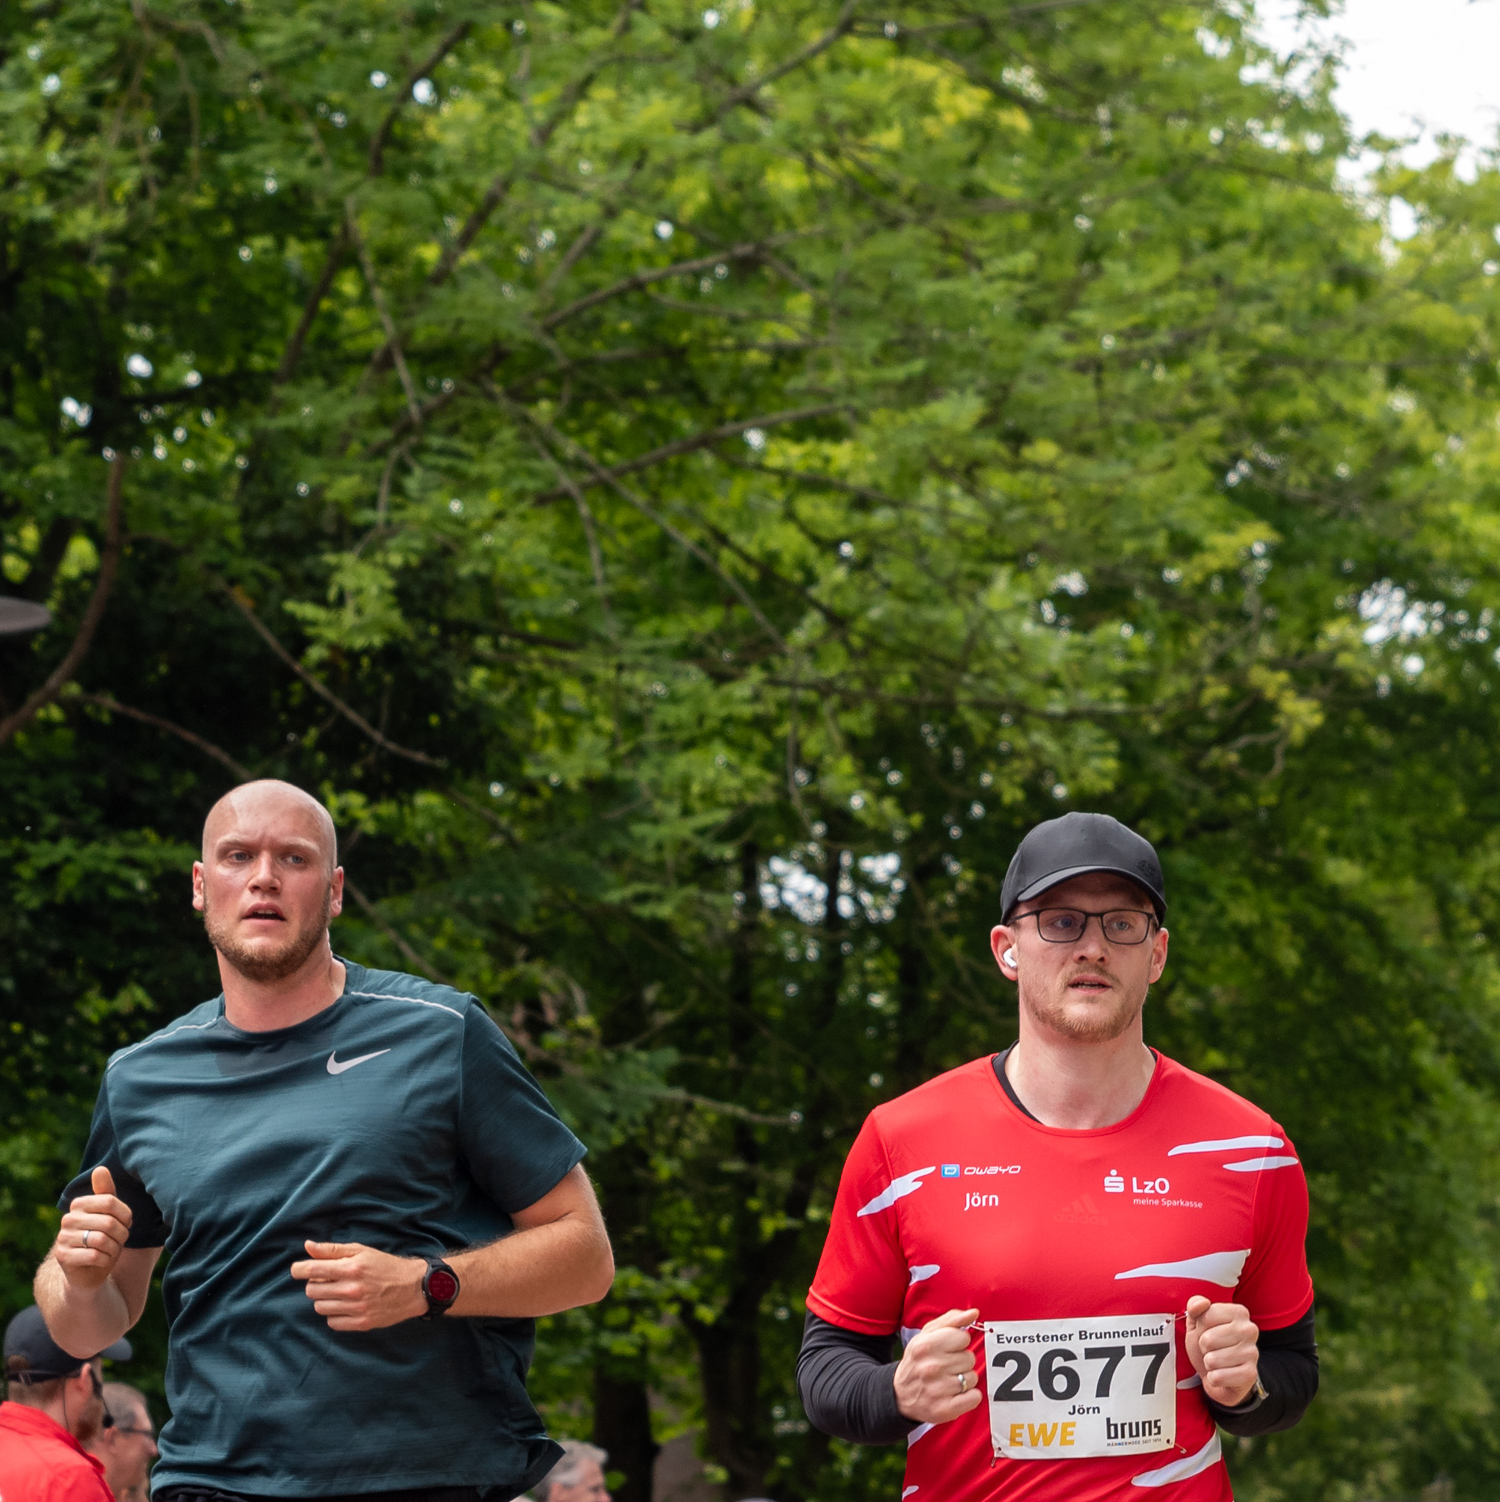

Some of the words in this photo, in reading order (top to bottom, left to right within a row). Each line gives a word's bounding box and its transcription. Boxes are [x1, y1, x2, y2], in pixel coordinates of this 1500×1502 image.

[1132, 1177, 1170, 1194] LzO
[964, 1192, 999, 1211] Jörn
[1133, 1197, 1159, 1206] meine
[1161, 1198, 1203, 1208] Sparkasse
[997, 1332, 1074, 1344] Everstener
[1079, 1325, 1165, 1341] Brunnenlauf
[992, 1342, 1170, 1402] 2677
[1068, 1405, 1100, 1415] Jörn
[1009, 1421, 1076, 1447] EWE
[1106, 1417, 1162, 1439] bruns
